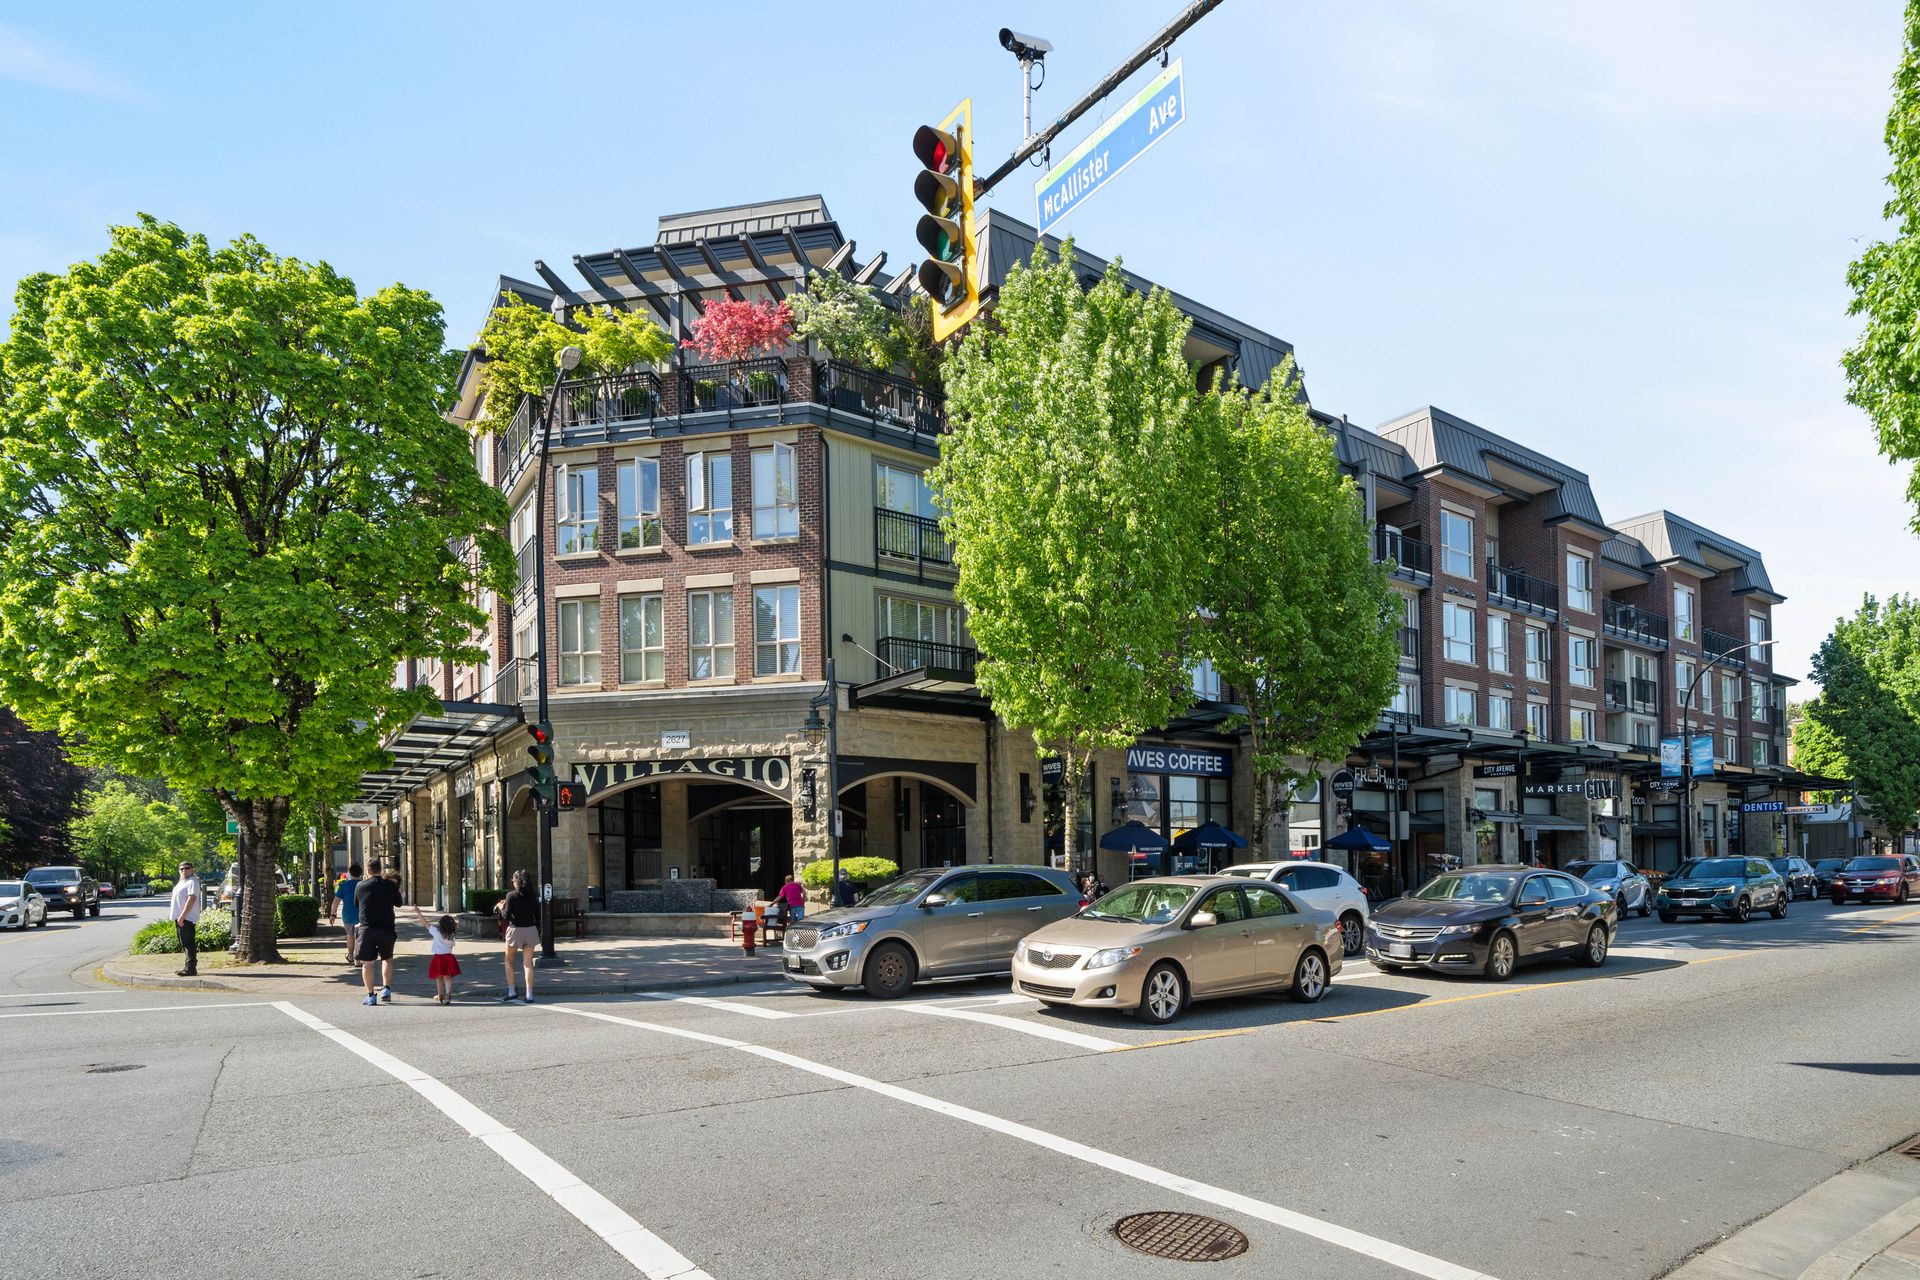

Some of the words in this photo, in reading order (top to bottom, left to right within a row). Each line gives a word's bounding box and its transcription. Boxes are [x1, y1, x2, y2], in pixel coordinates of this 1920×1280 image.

[1043, 150, 1110, 222] McAllister
[1149, 94, 1177, 135] Ave
[666, 734, 686, 744] 2627
[1126, 750, 1165, 768] AVES
[1168, 752, 1222, 772] COFFEE
[574, 757, 790, 796] VILLAGIO
[1525, 784, 1581, 794] MARKET
[1744, 802, 1784, 812] DENTIST
